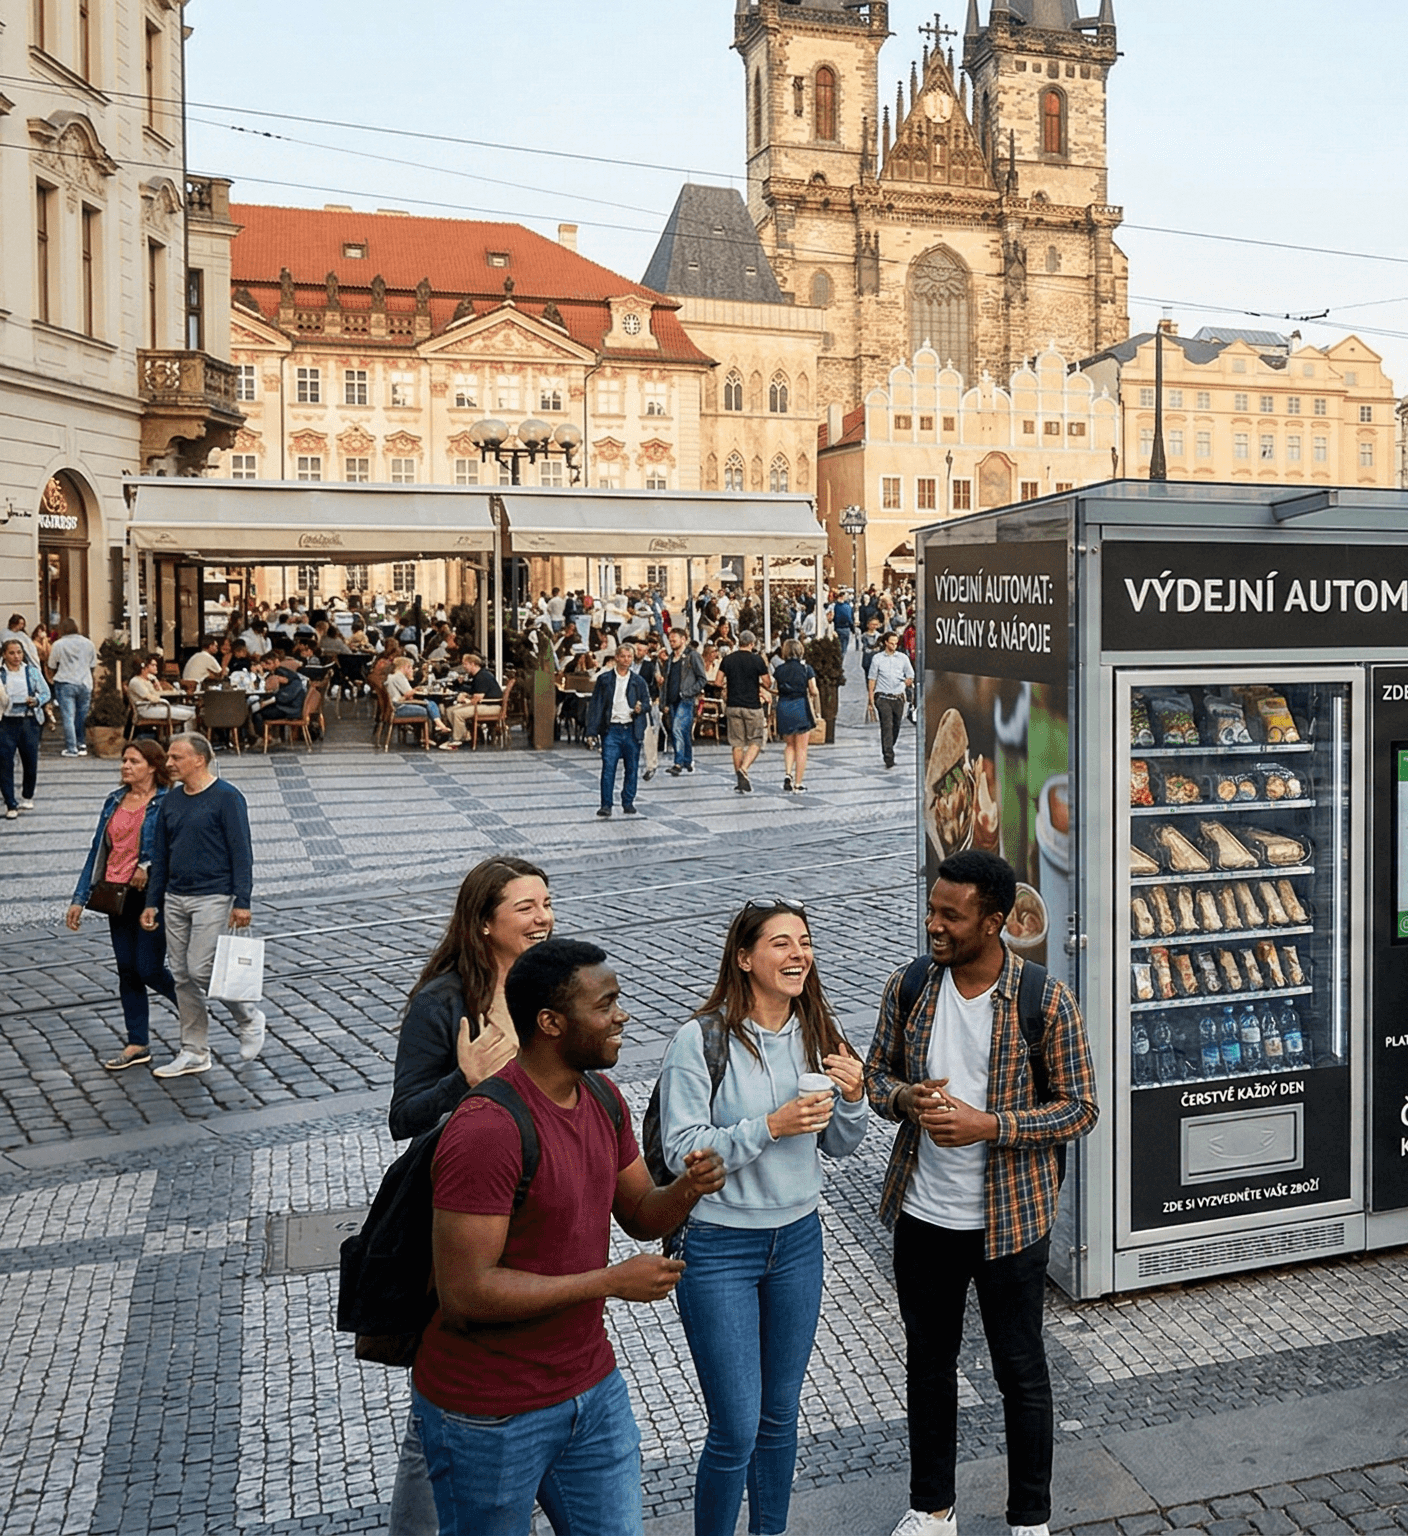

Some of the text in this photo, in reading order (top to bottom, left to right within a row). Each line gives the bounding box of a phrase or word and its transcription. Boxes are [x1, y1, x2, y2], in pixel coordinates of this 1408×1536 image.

[935, 568, 1053, 604] VÝDEJNÍ AUTOMAT:
[1124, 571, 1278, 612] VÝDEJNÍ
[936, 612, 1050, 653] SVAČINY & NÁPOJE
[1181, 1081, 1304, 1106] ČERSTVÉ KAŽDÝ DEN
[1162, 1200, 1184, 1213] ZDE
[1185, 1198, 1196, 1210] SI
[1263, 1183, 1287, 1197] VAŠE
